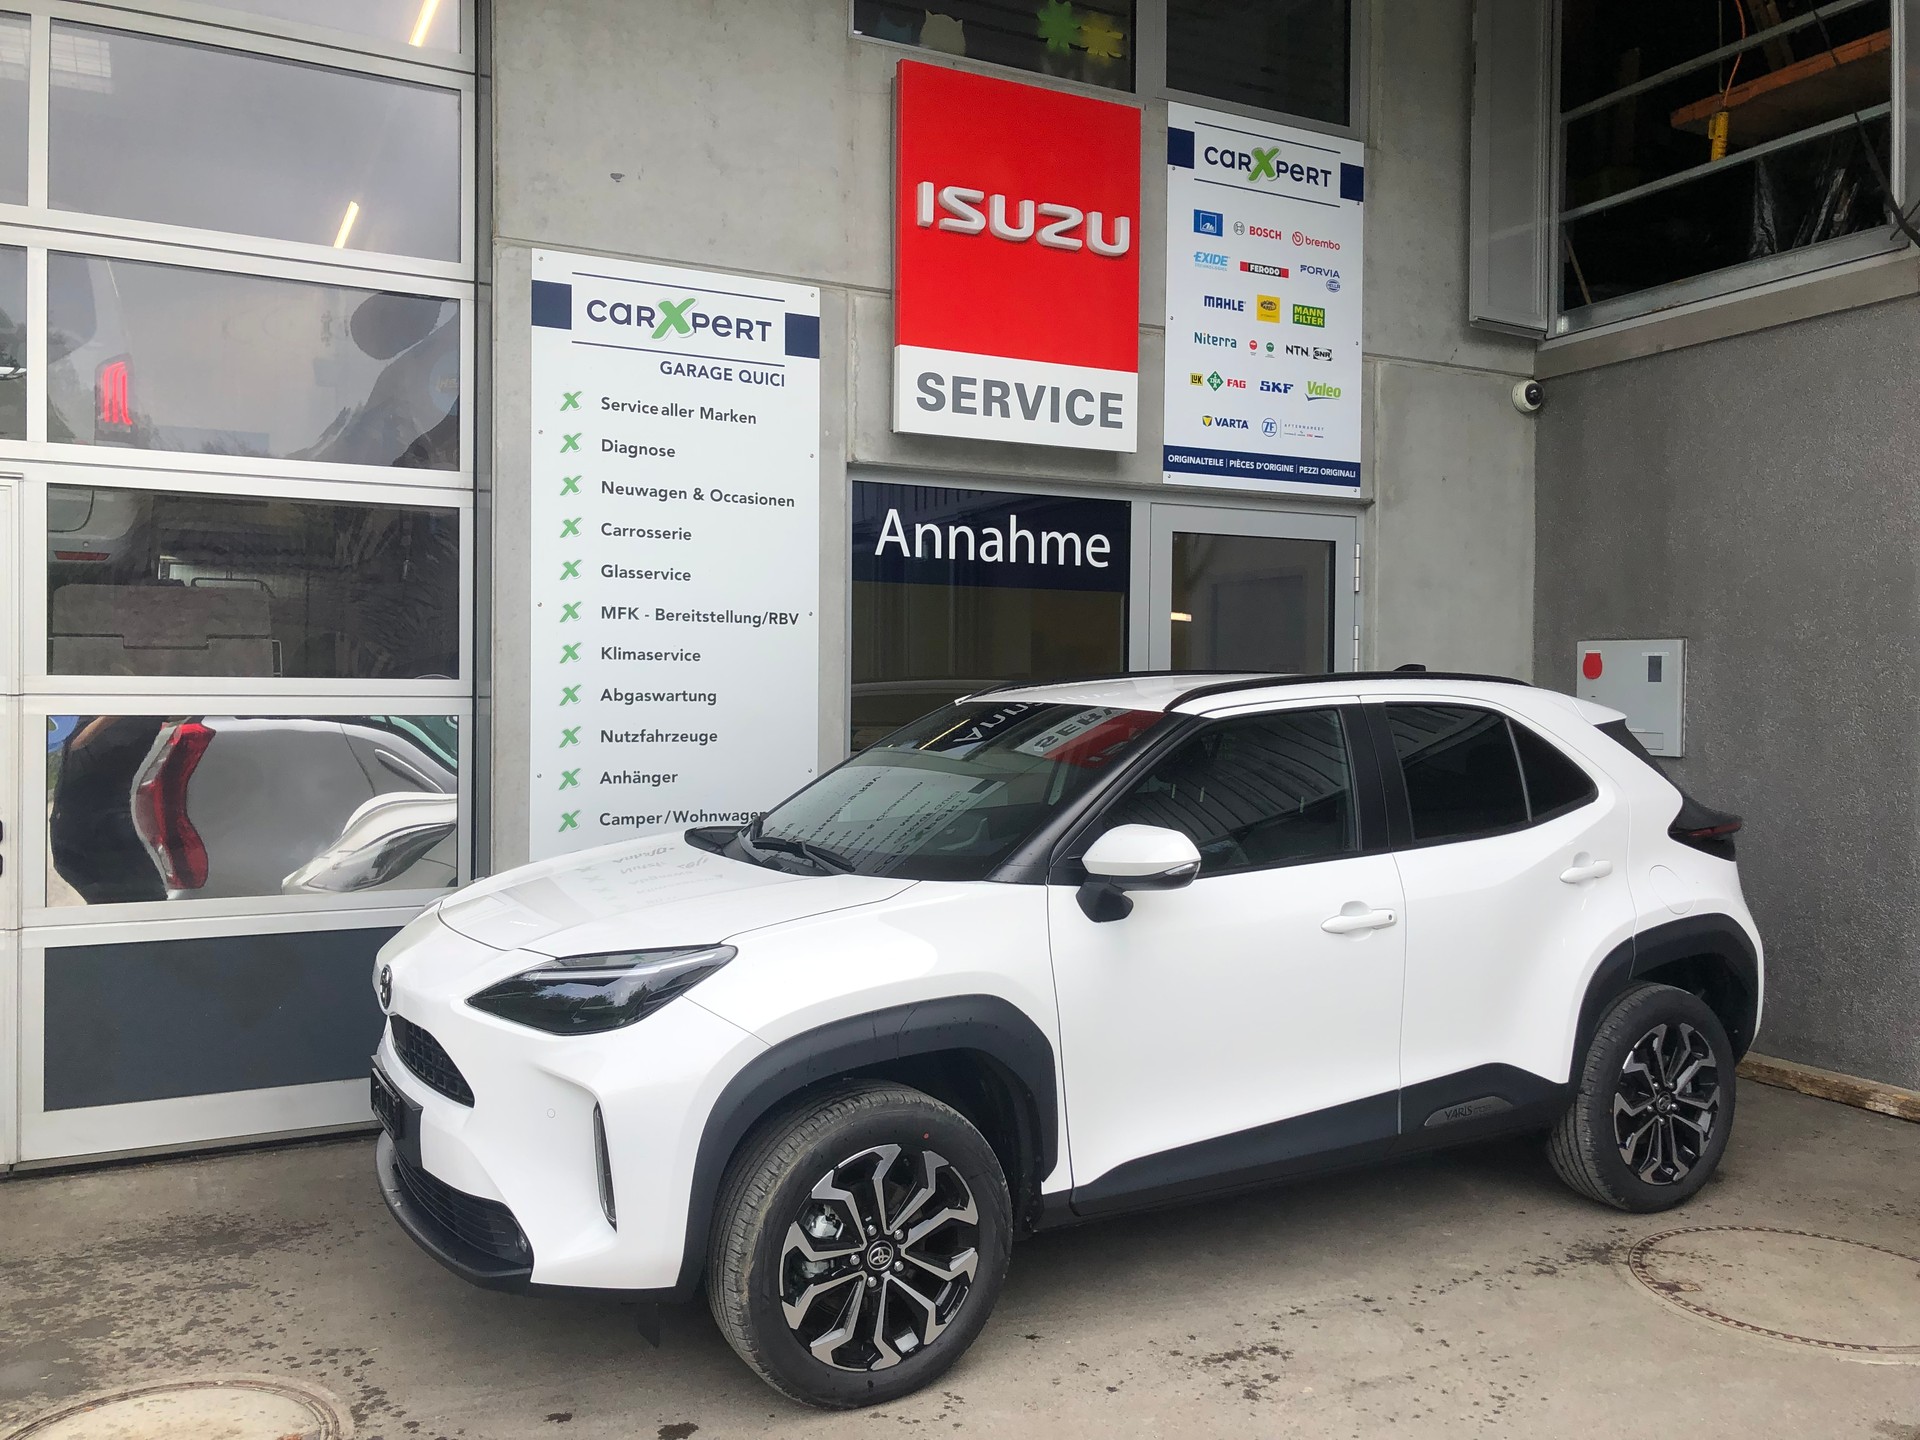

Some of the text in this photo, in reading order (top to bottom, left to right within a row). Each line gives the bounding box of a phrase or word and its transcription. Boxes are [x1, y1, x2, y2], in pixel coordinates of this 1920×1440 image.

[916, 181, 1131, 257] ISUZU
[1250, 226, 1281, 240] BOSCH
[1306, 236, 1340, 250] brembo
[1194, 251, 1228, 266] EXIDE
[1250, 264, 1280, 276] FERODO
[1300, 265, 1340, 279] FORVIA
[1204, 296, 1244, 311] MAHLE
[1294, 305, 1324, 317] MANN
[1294, 314, 1324, 326] FILTER
[1195, 332, 1236, 348] Niterra
[1286, 345, 1308, 356] NTN
[1314, 350, 1331, 358] SNR
[660, 361, 785, 387] GARAGE QUICI
[1227, 379, 1246, 388] FAG
[1260, 381, 1293, 393] SKF
[1307, 381, 1341, 398] Valeo
[917, 372, 1123, 429] SERVICE
[602, 397, 756, 424] Service aller Marken
[1215, 417, 1248, 429] VARTA
[1264, 422, 1275, 432] ZF
[602, 439, 675, 458] Diagnose
[1168, 454, 1223, 467] ORIGINALTEILE
[1230, 459, 1254, 469] PIÈCES
[1299, 466, 1319, 475] PEZZI
[1320, 468, 1356, 478] ORIGINALI
[602, 481, 794, 507] Neuwagen & Occasionen
[601, 523, 691, 540] Carrosserie
[875, 508, 1111, 568] Annahme
[601, 564, 691, 581] Glasservice
[602, 606, 639, 620] MFK
[656, 608, 799, 627] Bereitstellung/RBV
[602, 647, 700, 661] Klimaservice
[601, 688, 716, 705] Abgaswartung
[601, 729, 717, 746] Nutzfahrzeuge
[600, 770, 678, 787] Anhänger
